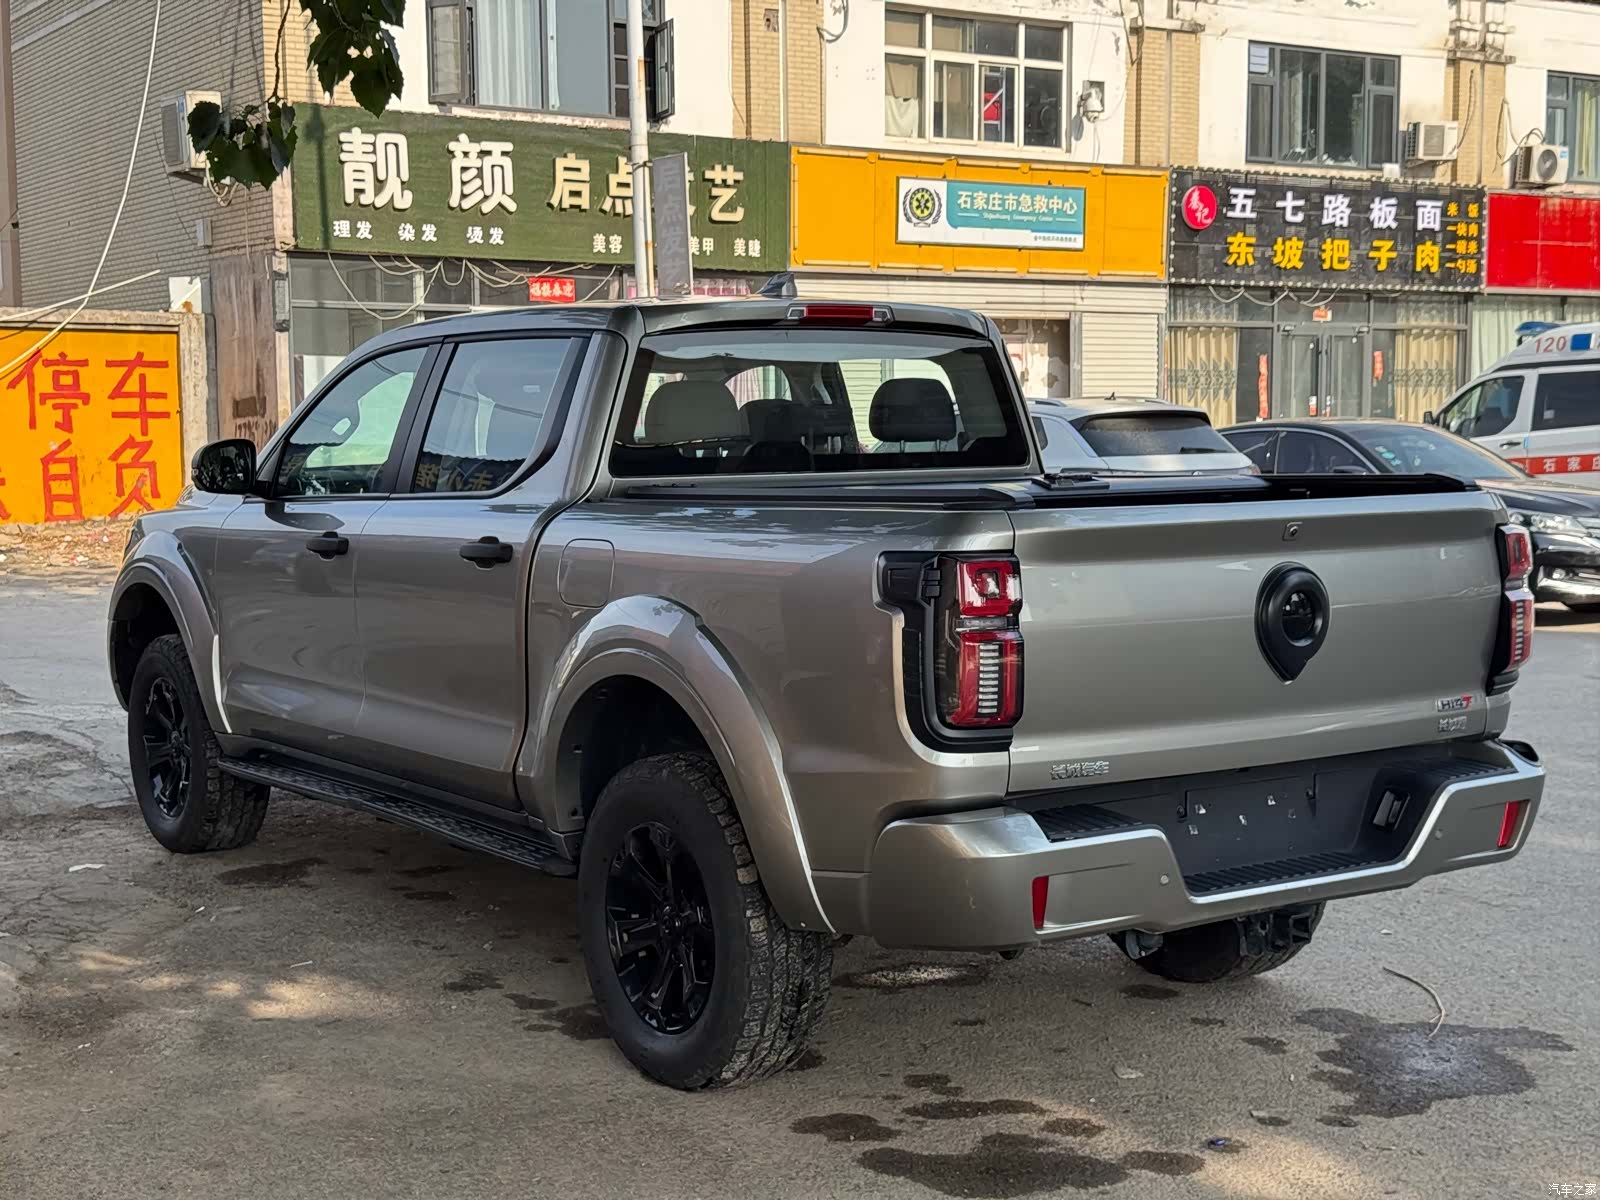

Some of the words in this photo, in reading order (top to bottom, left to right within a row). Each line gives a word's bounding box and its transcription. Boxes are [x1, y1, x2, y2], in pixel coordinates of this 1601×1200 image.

[339, 126, 518, 215] 靓颜
[548, 152, 746, 223] 启点艺
[957, 190, 1078, 215] 石家庄市急救中心
[1226, 186, 1444, 232] 五七路板面
[1446, 201, 1479, 219] 米饭
[333, 219, 373, 240] 理发
[398, 222, 438, 242] 染发
[466, 225, 505, 246] 烫发
[1446, 221, 1479, 238] 一块肉
[592, 232, 623, 254] 美容
[688, 236, 714, 256] 美甲
[1226, 231, 1441, 274] 东坡把子肉
[1535, 335, 1568, 354] 120
[6, 348, 171, 437] 停车
